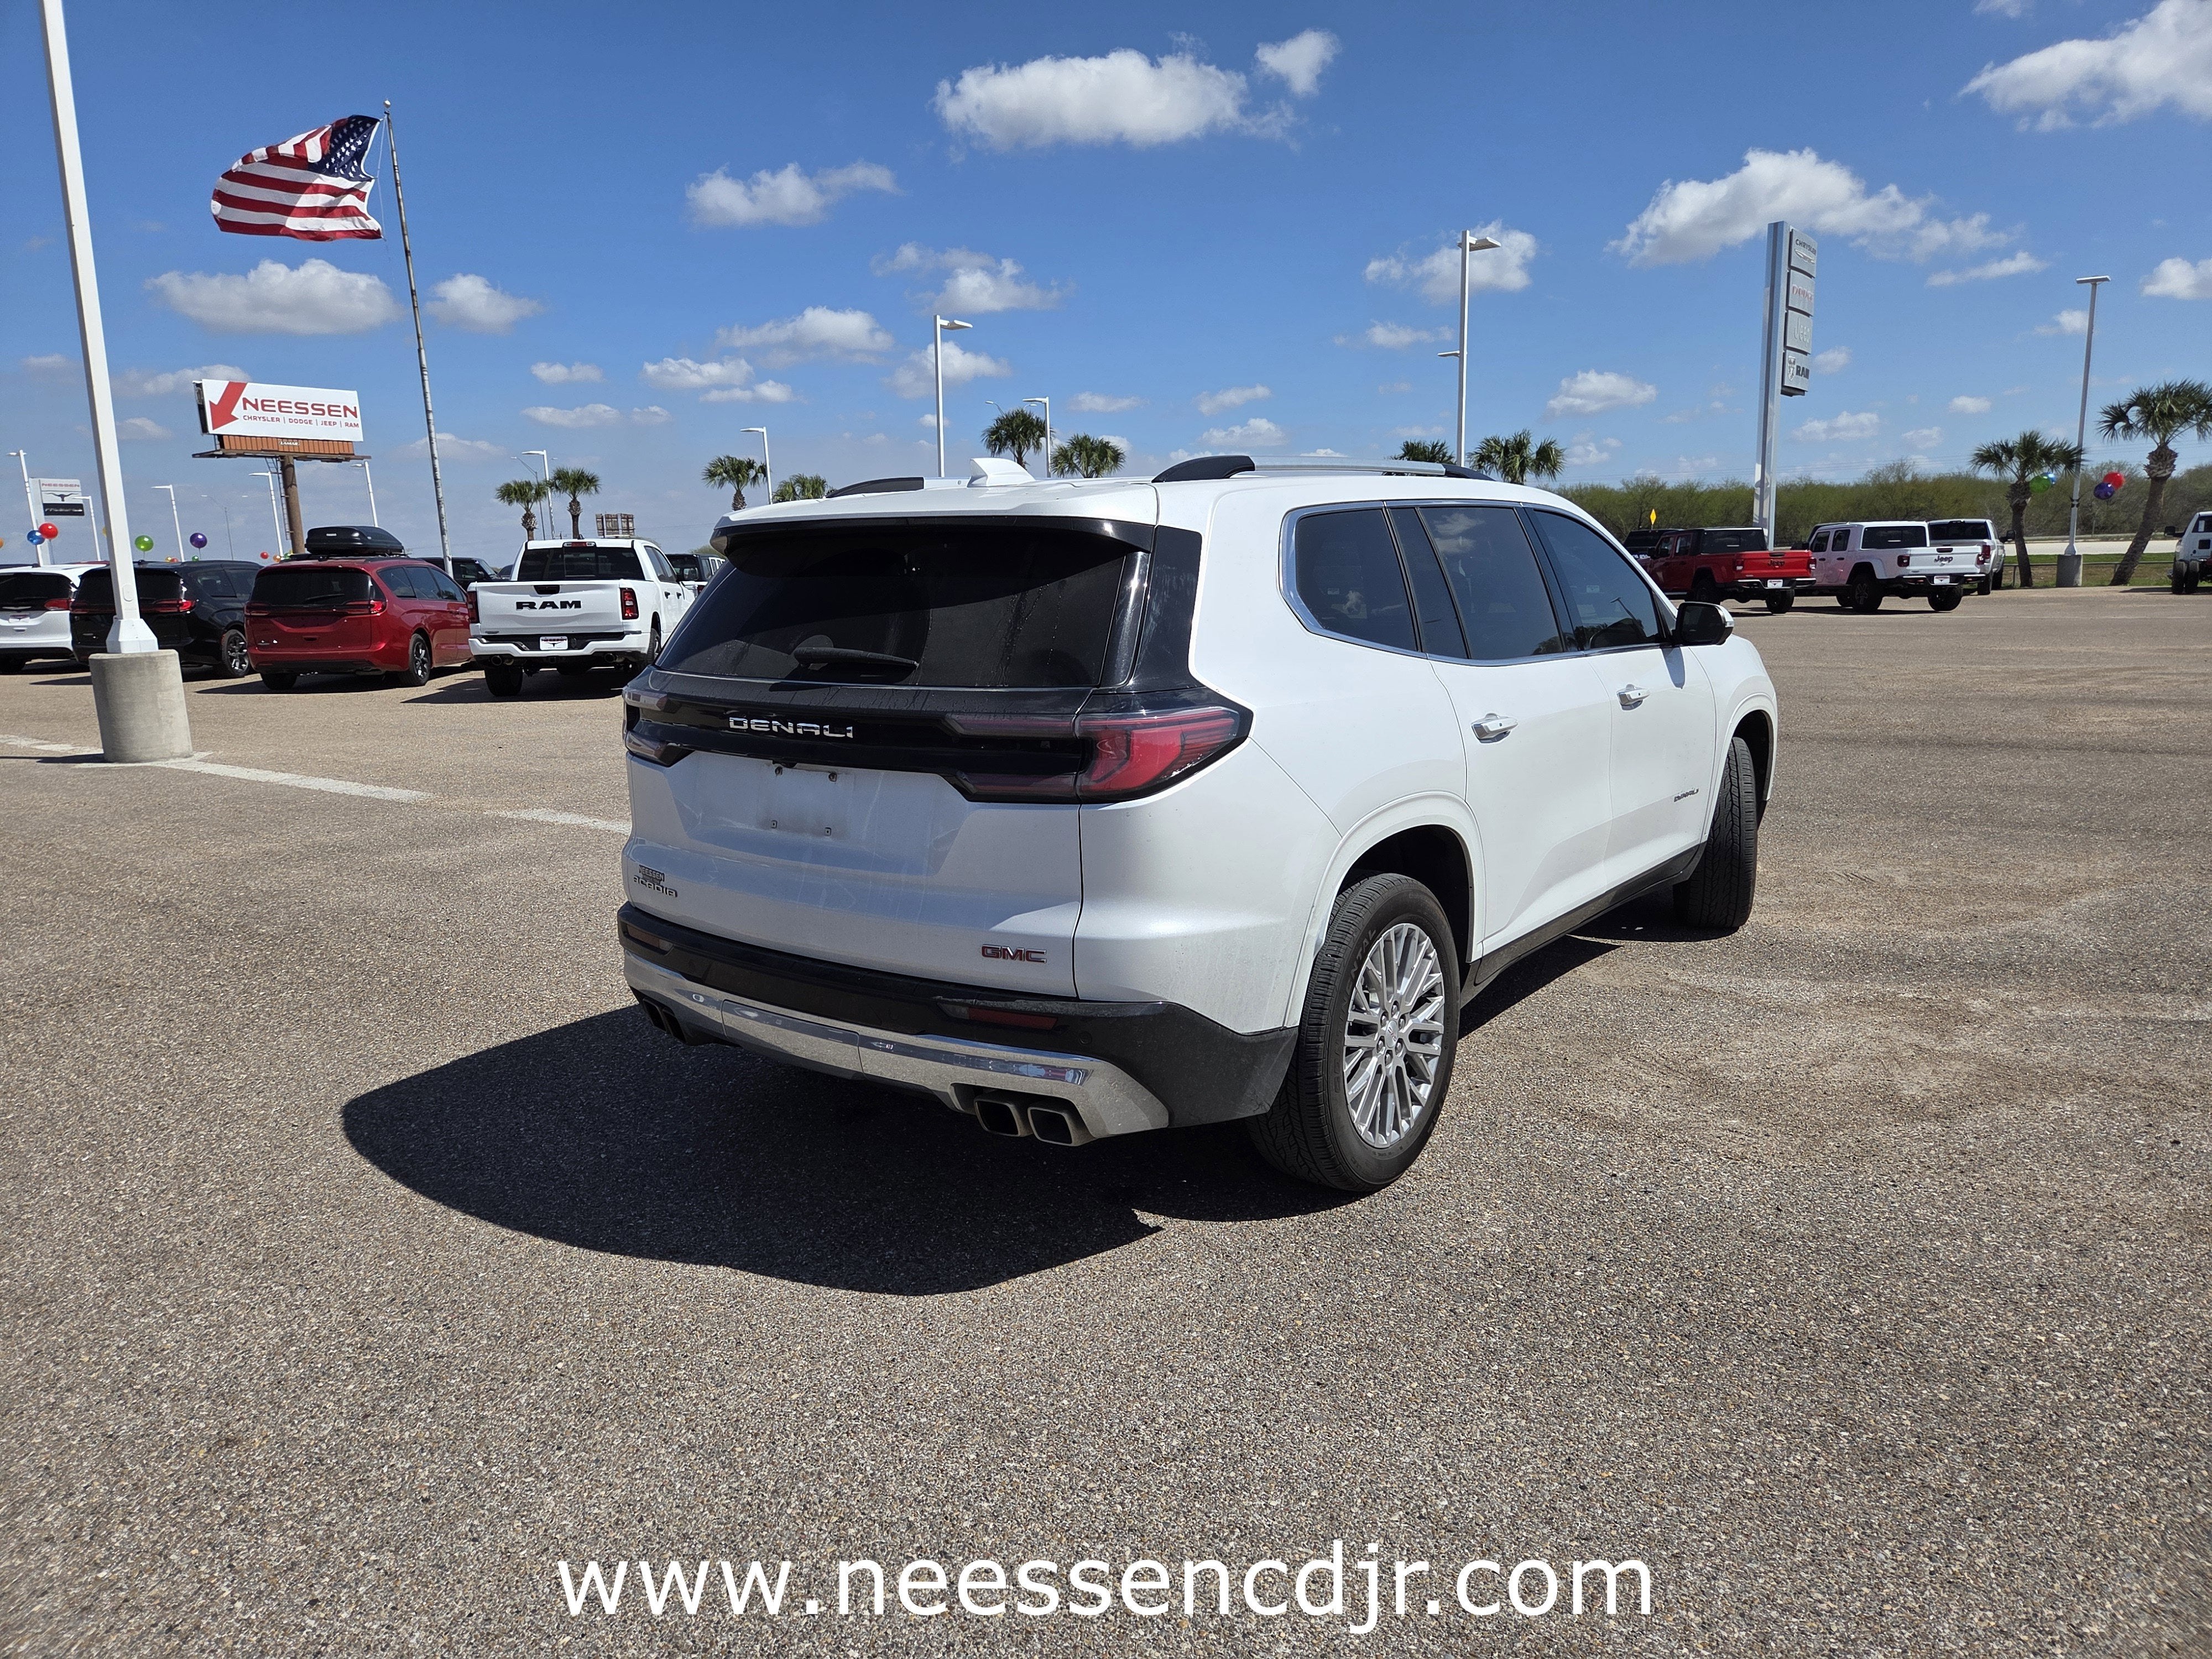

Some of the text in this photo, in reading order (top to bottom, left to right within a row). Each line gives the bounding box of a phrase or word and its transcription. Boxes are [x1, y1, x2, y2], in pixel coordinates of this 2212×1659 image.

[1795, 239, 1816, 255] CHRYSLER
[1796, 365, 1810, 379] RAM
[242, 397, 358, 419] NEESSEN
[1933, 555, 1953, 564] Jeep
[516, 601, 581, 611] RAM
[729, 717, 853, 738] DENALI
[981, 944, 1047, 964] GMC
